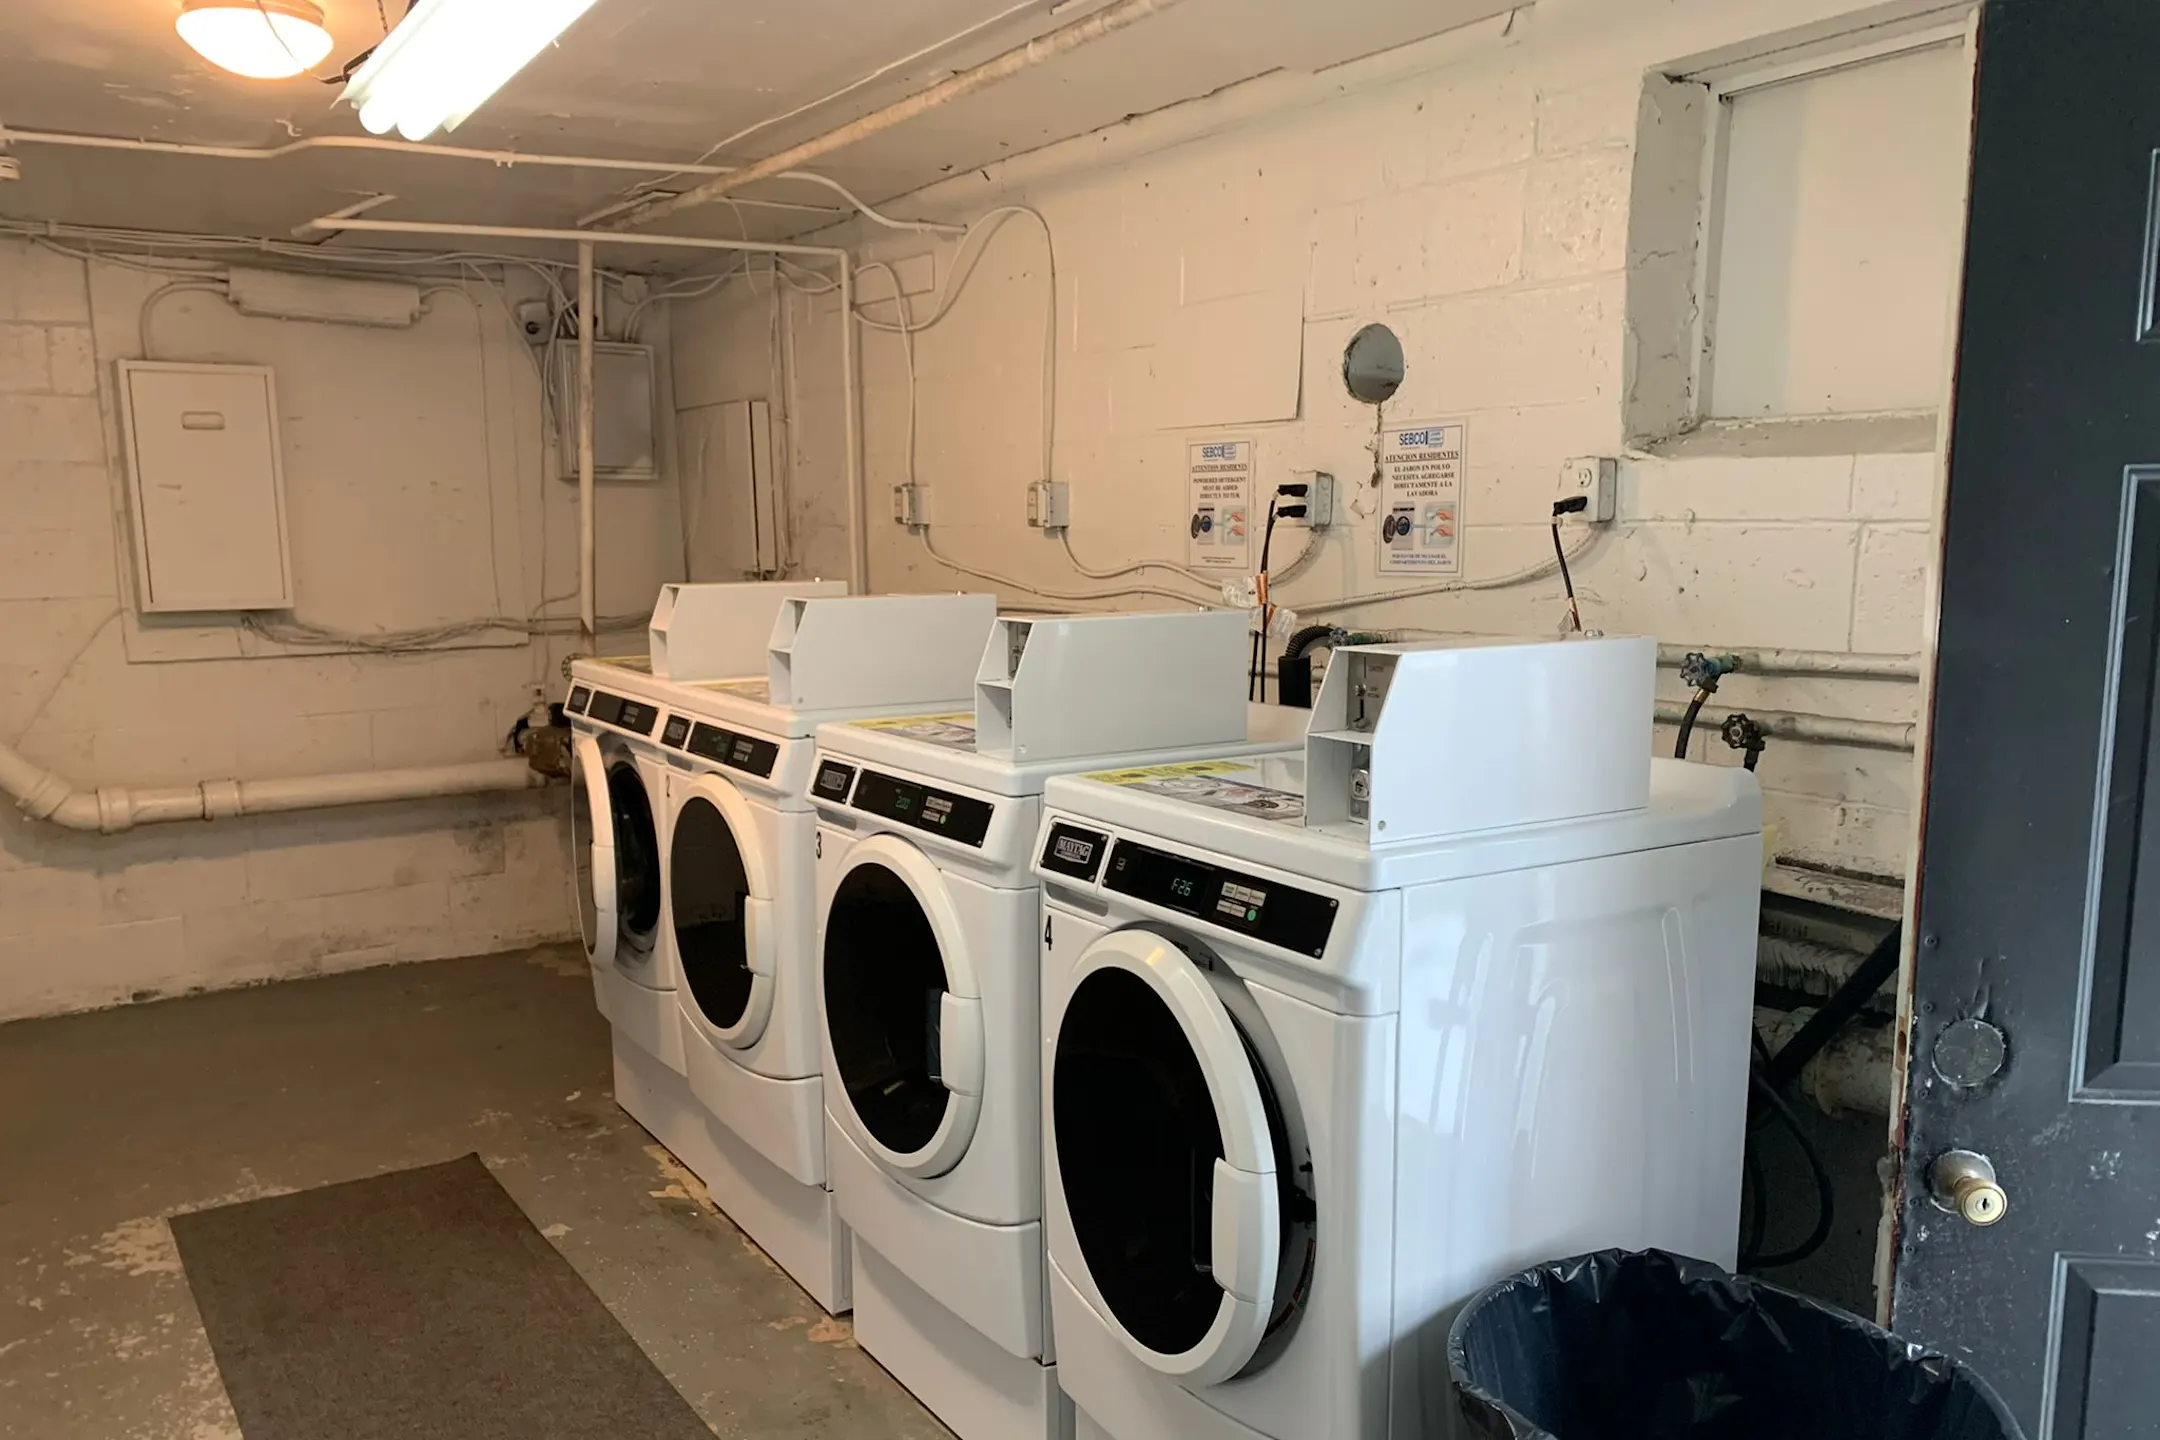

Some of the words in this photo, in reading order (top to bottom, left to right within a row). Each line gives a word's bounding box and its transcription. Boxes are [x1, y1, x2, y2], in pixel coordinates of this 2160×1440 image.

[1399, 431, 1425, 446] SEBCO
[1202, 446, 1223, 458] SEBCO
[1385, 453, 1417, 462] ATENCION
[1419, 451, 1459, 460] RESIDENTES
[1192, 464, 1219, 472] ATTENTION
[1220, 463, 1247, 471] RESIDENTS
[1394, 481, 1438, 489] DIRECTAMENTE
[815, 831, 822, 859] 3
[1057, 839, 1090, 857] MAYTAG
[1170, 877, 1194, 897] F26
[1044, 914, 1052, 951] 4
